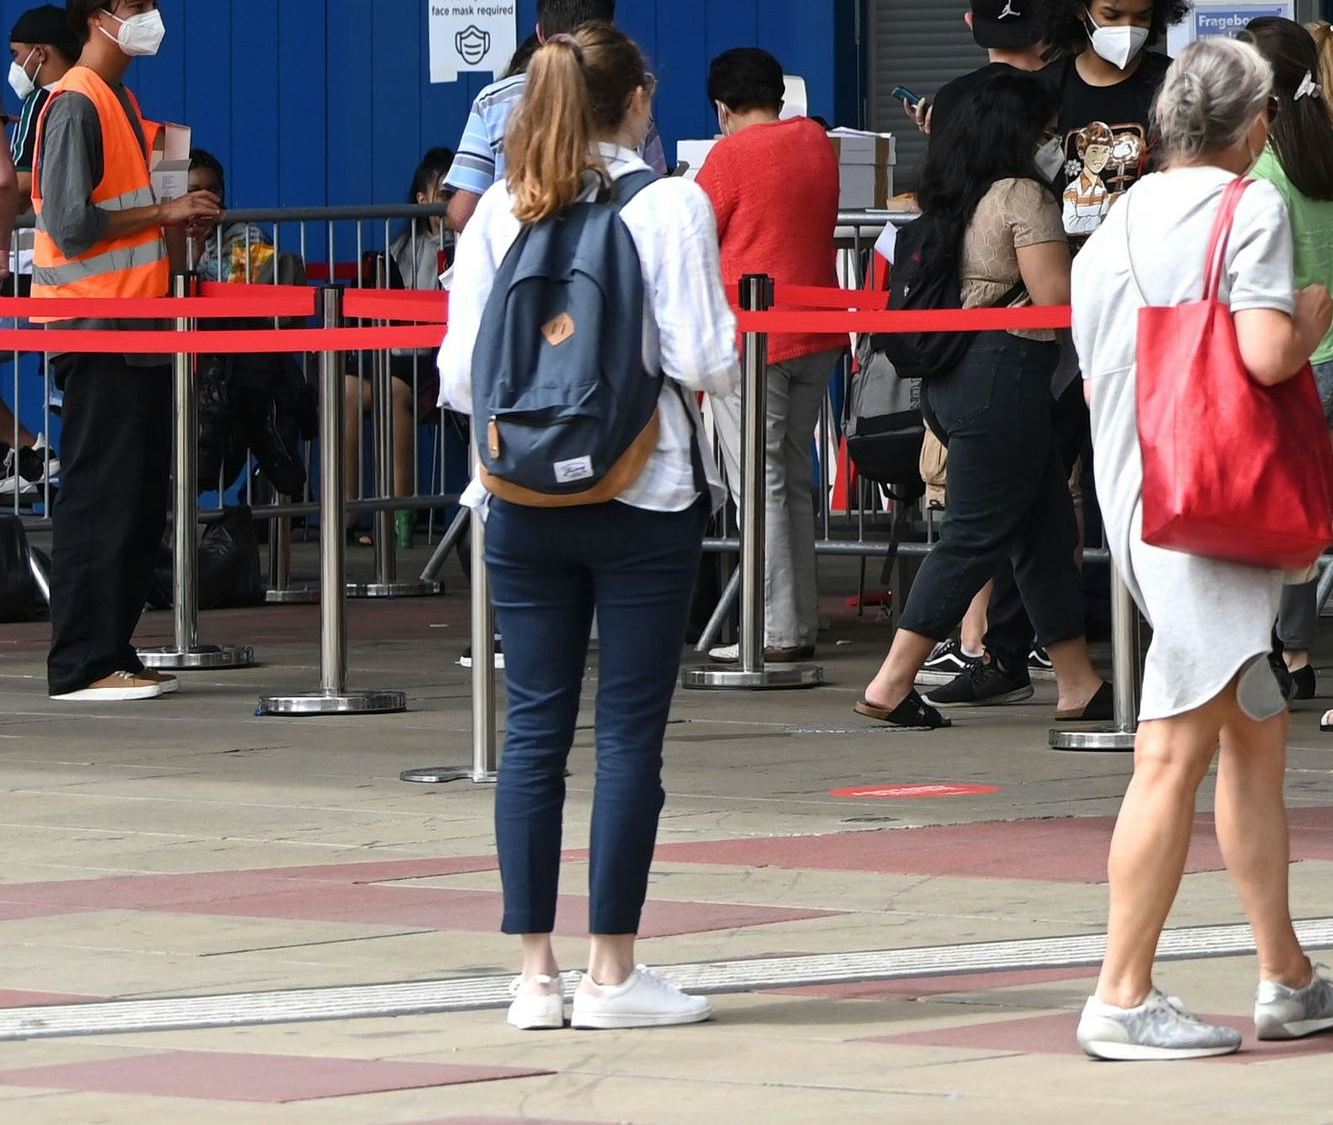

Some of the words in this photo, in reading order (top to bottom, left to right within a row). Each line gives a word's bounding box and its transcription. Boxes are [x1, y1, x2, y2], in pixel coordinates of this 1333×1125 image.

[432, 6, 449, 16] face
[452, 5, 474, 16] mask
[477, 5, 514, 17] required
[1198, 14, 1253, 30] Fragebo
